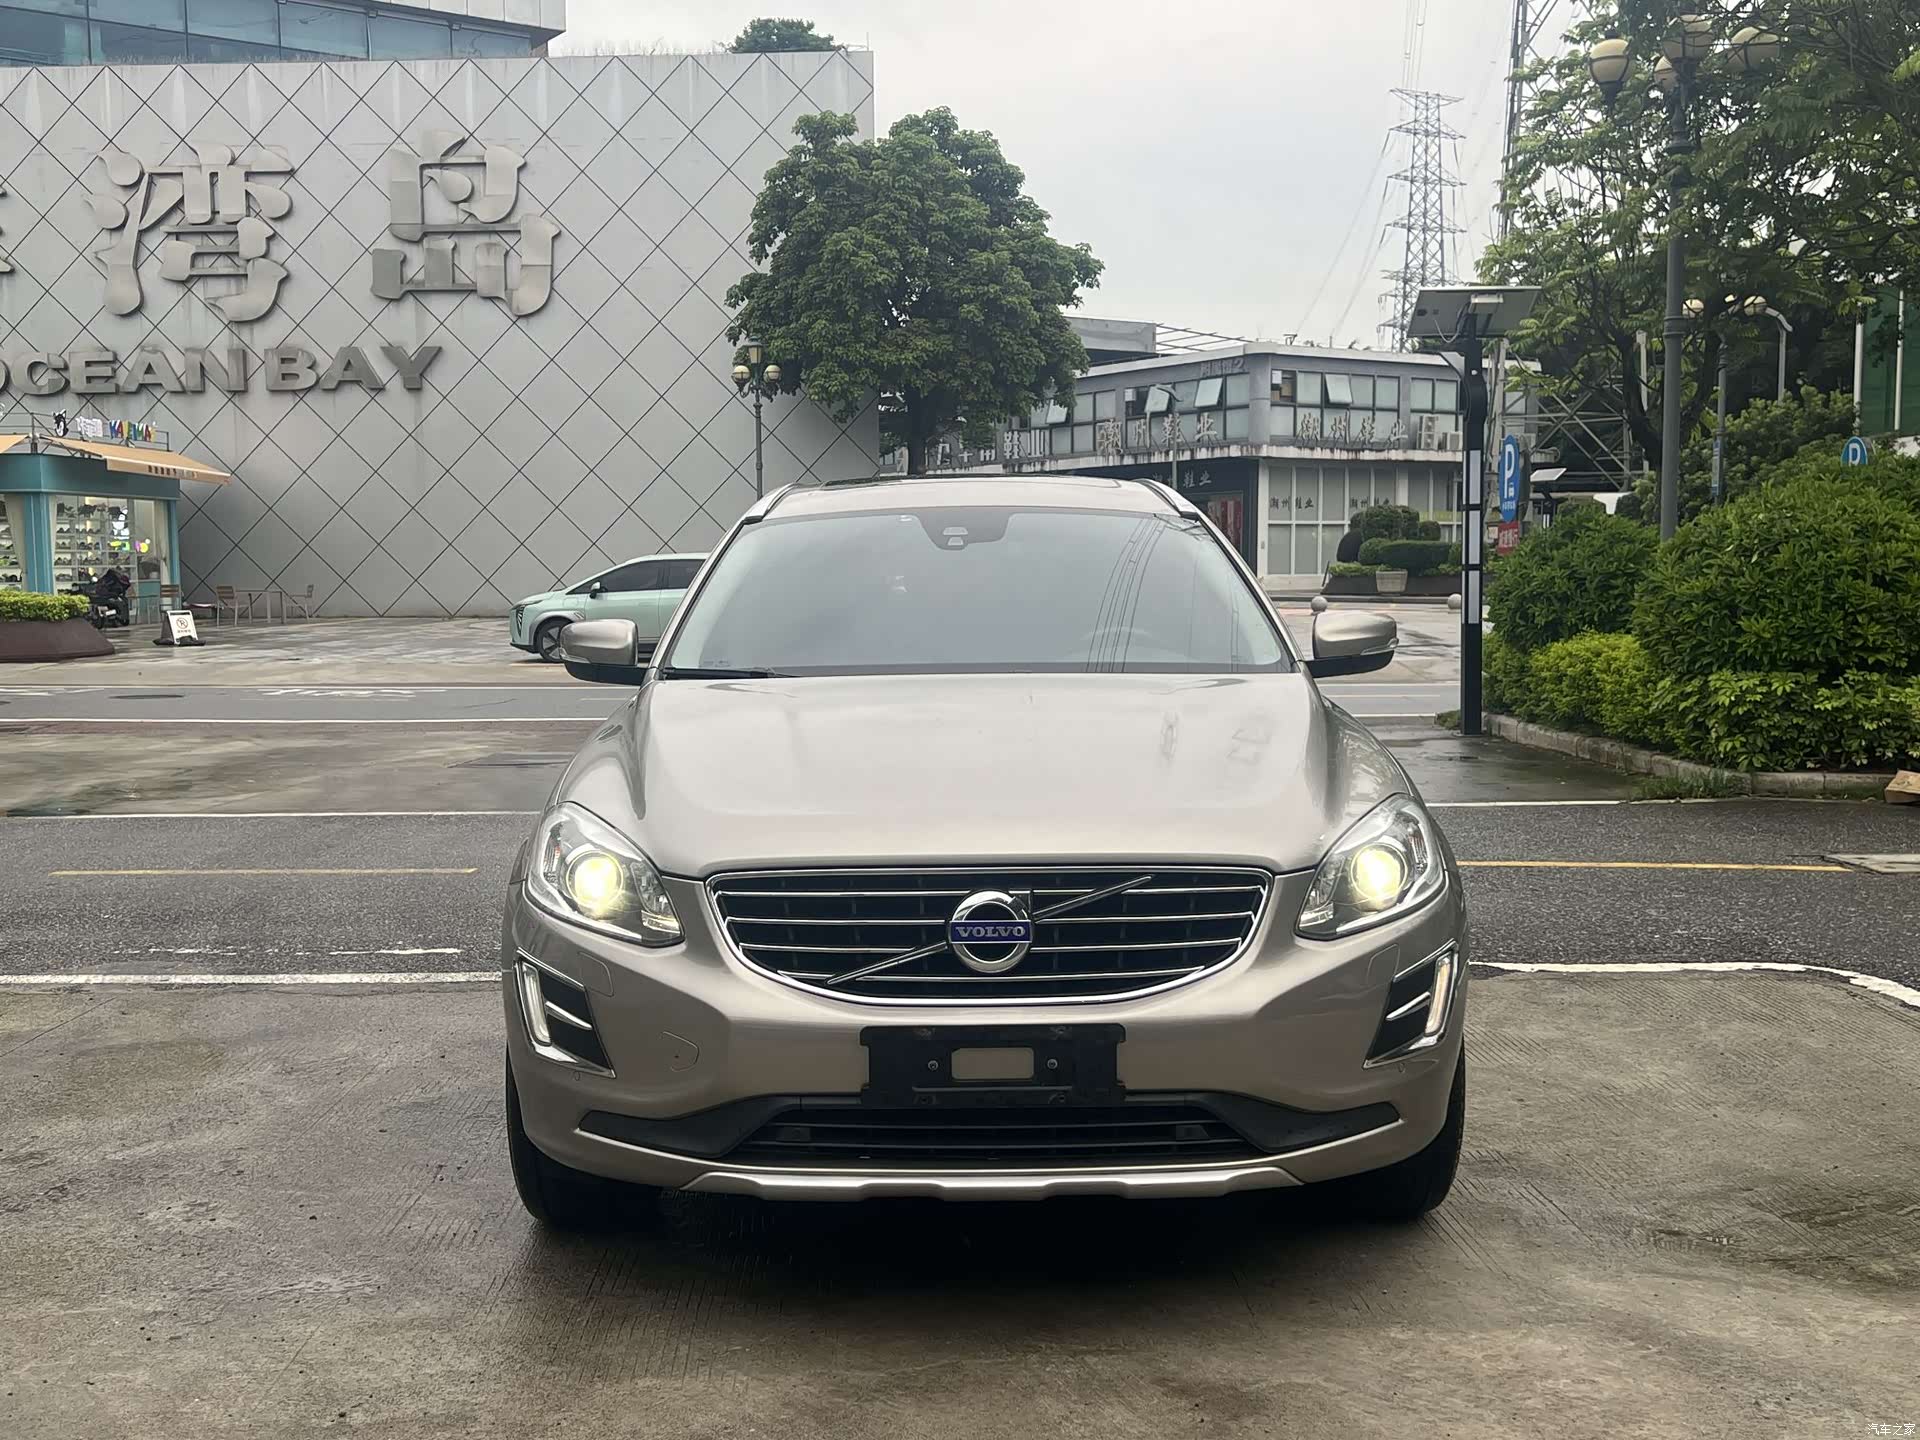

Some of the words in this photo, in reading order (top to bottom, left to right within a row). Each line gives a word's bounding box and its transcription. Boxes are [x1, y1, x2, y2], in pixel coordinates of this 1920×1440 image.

[0, 130, 562, 323] 湾岛
[0, 347, 250, 396] CEAN
[263, 344, 443, 393] BAY
[1098, 411, 1218, 456] 潮州鞋业
[1300, 409, 1408, 444] 潮州鞋业
[1504, 443, 1515, 499] P
[955, 926, 1025, 937] VOLVO
